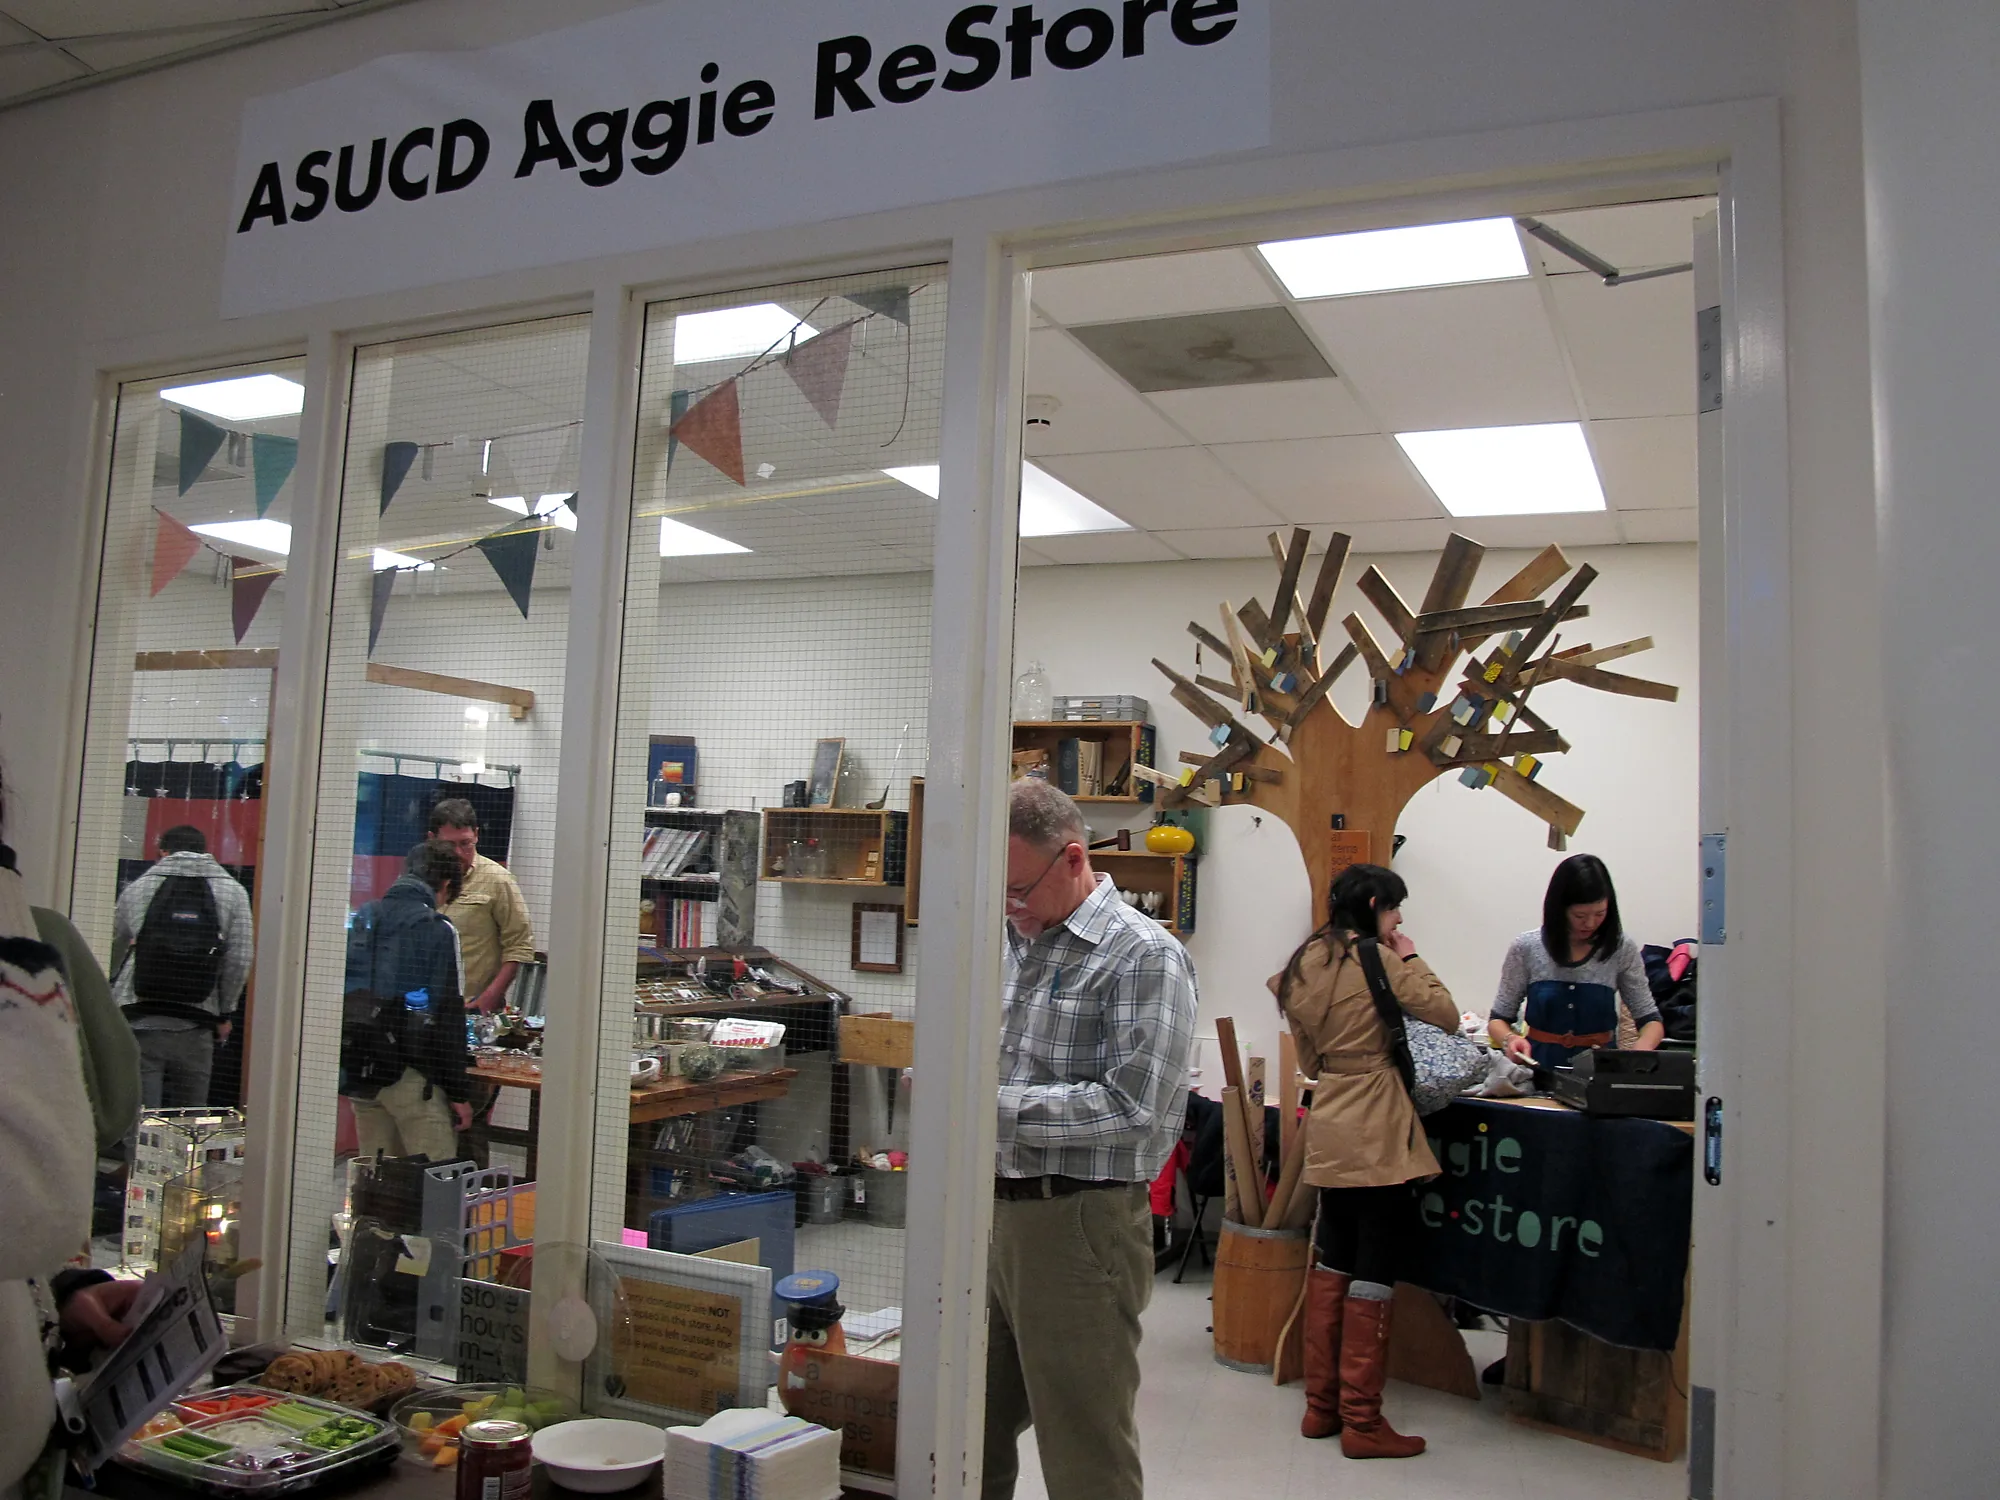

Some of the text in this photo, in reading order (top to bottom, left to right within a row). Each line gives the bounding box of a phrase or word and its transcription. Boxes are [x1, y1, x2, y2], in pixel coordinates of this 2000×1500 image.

[237, 0, 1239, 234] ASUCD Aggie ReStore
[460, 1307, 524, 1343] hours
[708, 1306, 730, 1318] NOT
